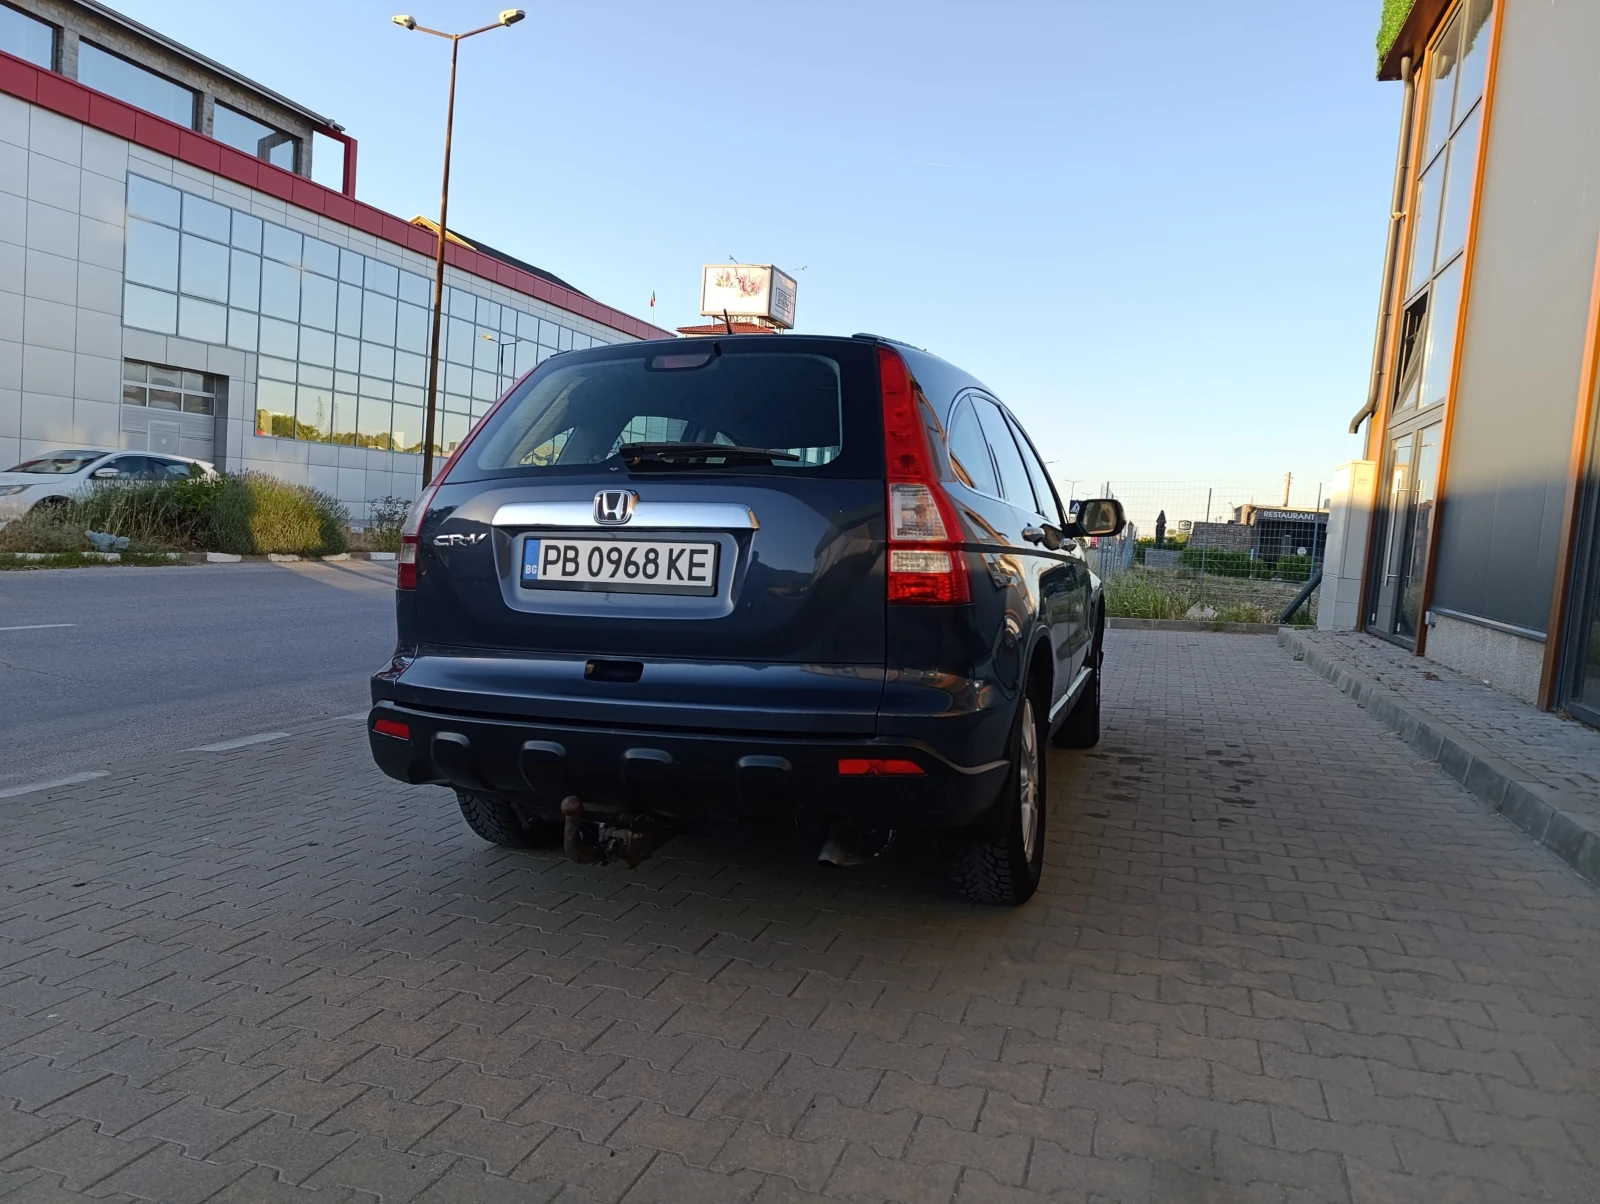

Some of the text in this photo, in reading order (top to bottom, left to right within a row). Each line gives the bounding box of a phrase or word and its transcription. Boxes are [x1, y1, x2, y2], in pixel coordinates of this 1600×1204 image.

[1263, 511, 1315, 520] RESTAURANT
[542, 545, 708, 582] PB 0968 KE
[525, 564, 537, 574] BG
